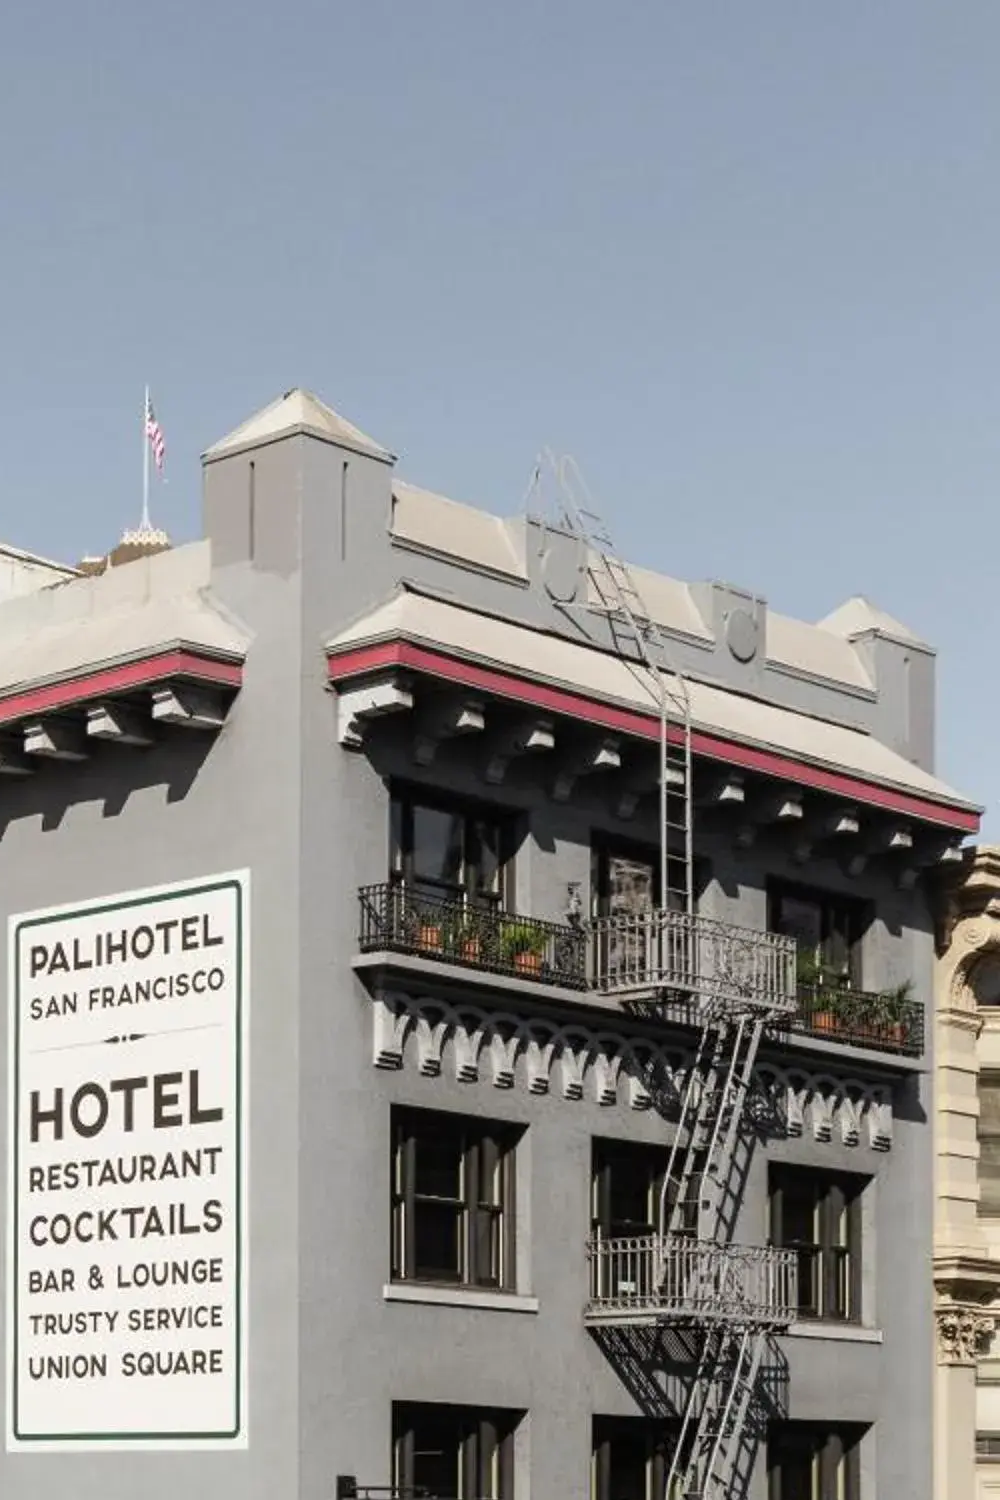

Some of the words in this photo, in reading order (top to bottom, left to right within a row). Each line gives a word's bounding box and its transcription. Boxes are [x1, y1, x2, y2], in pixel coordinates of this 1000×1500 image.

[30, 913, 224, 979] PALIHOTEL
[30, 988, 77, 1021] SAN
[89, 967, 225, 1012] FRANCISCO
[30, 1069, 224, 1143] HOTEL
[29, 1147, 223, 1193] RESTAURANT
[29, 1199, 224, 1247] COCKTAILS
[29, 1268, 75, 1294] BAR
[88, 1264, 105, 1291] &
[117, 1257, 224, 1289] LOUNGE
[29, 1311, 119, 1336] TRUSTY
[128, 1305, 223, 1331] SERVICE
[29, 1354, 107, 1381] UNION
[122, 1349, 223, 1377] SQUARE
